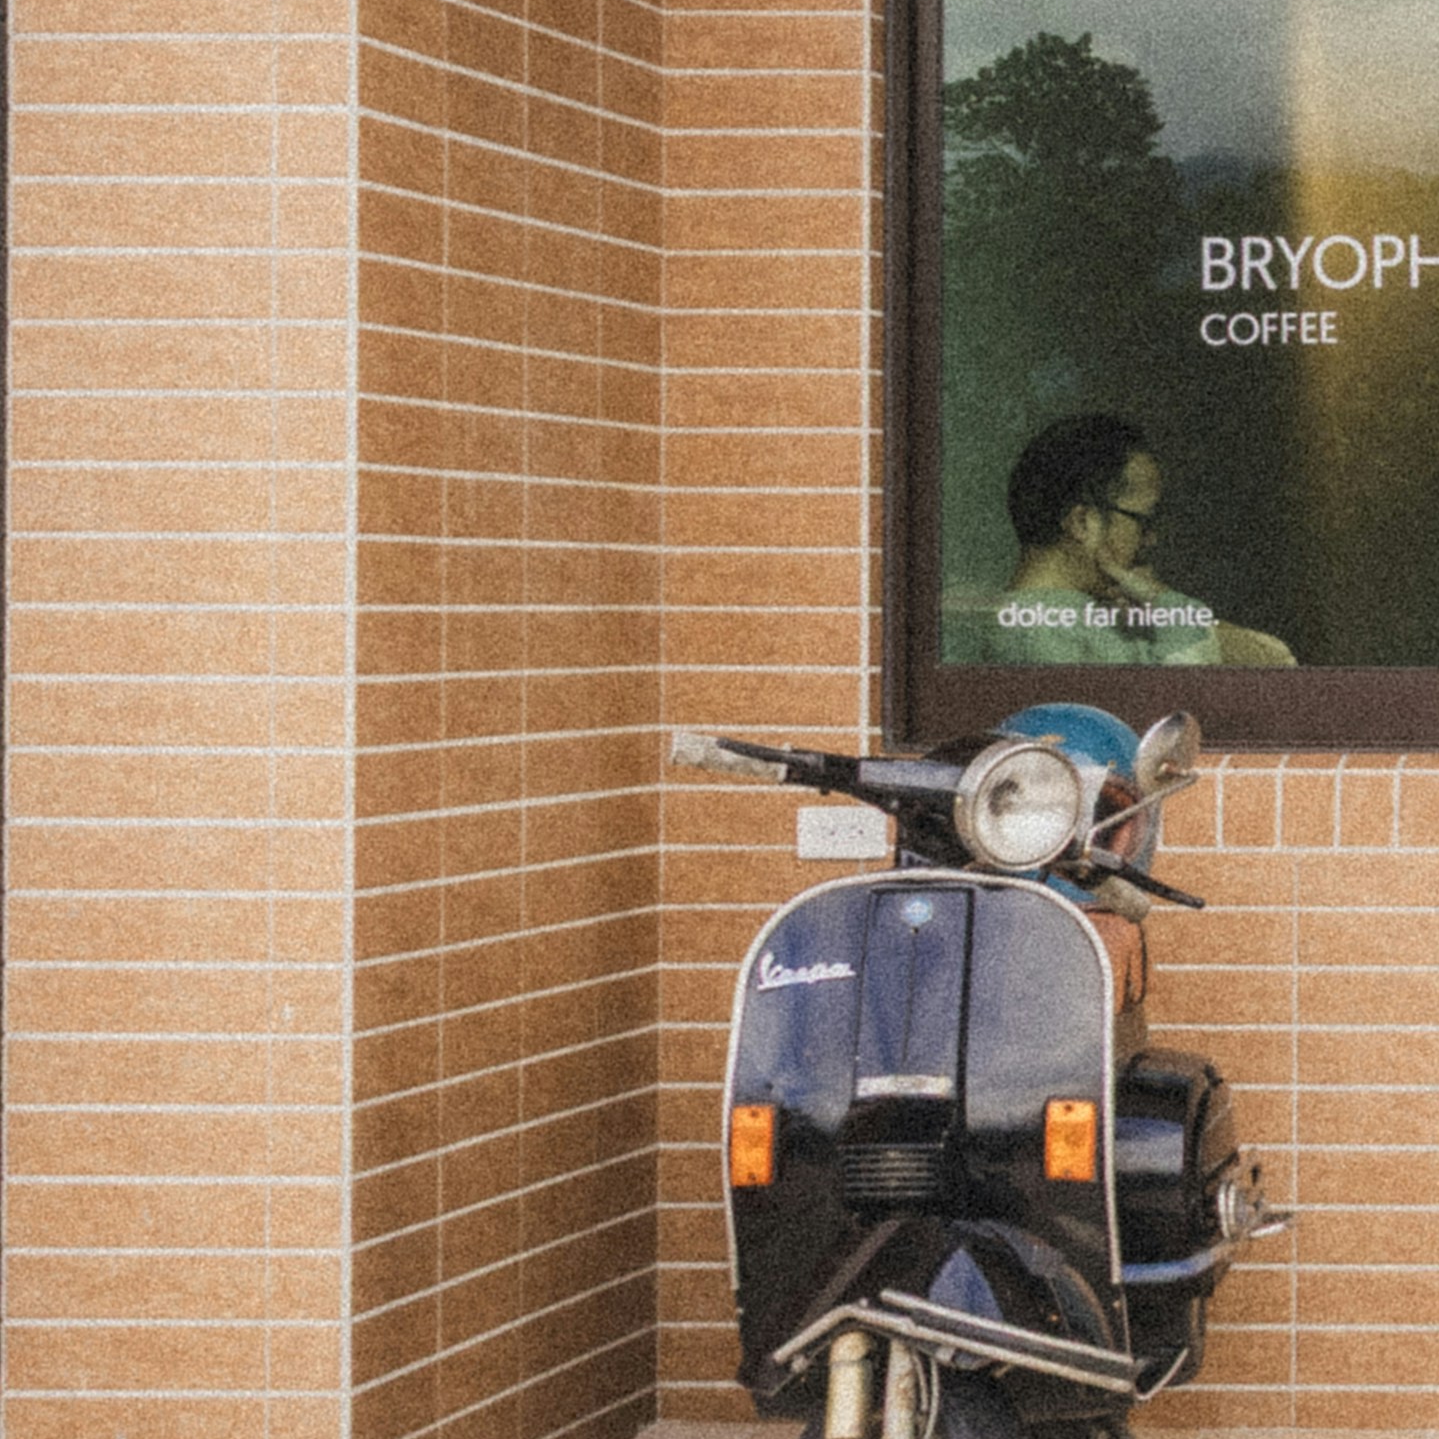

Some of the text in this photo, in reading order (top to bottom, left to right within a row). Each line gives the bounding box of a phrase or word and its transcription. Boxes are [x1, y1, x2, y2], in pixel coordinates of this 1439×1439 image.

[1200, 310, 1338, 346] COFFEE
[997, 602, 1219, 629] dolce far niente.
[757, 951, 856, 992] Vespa
